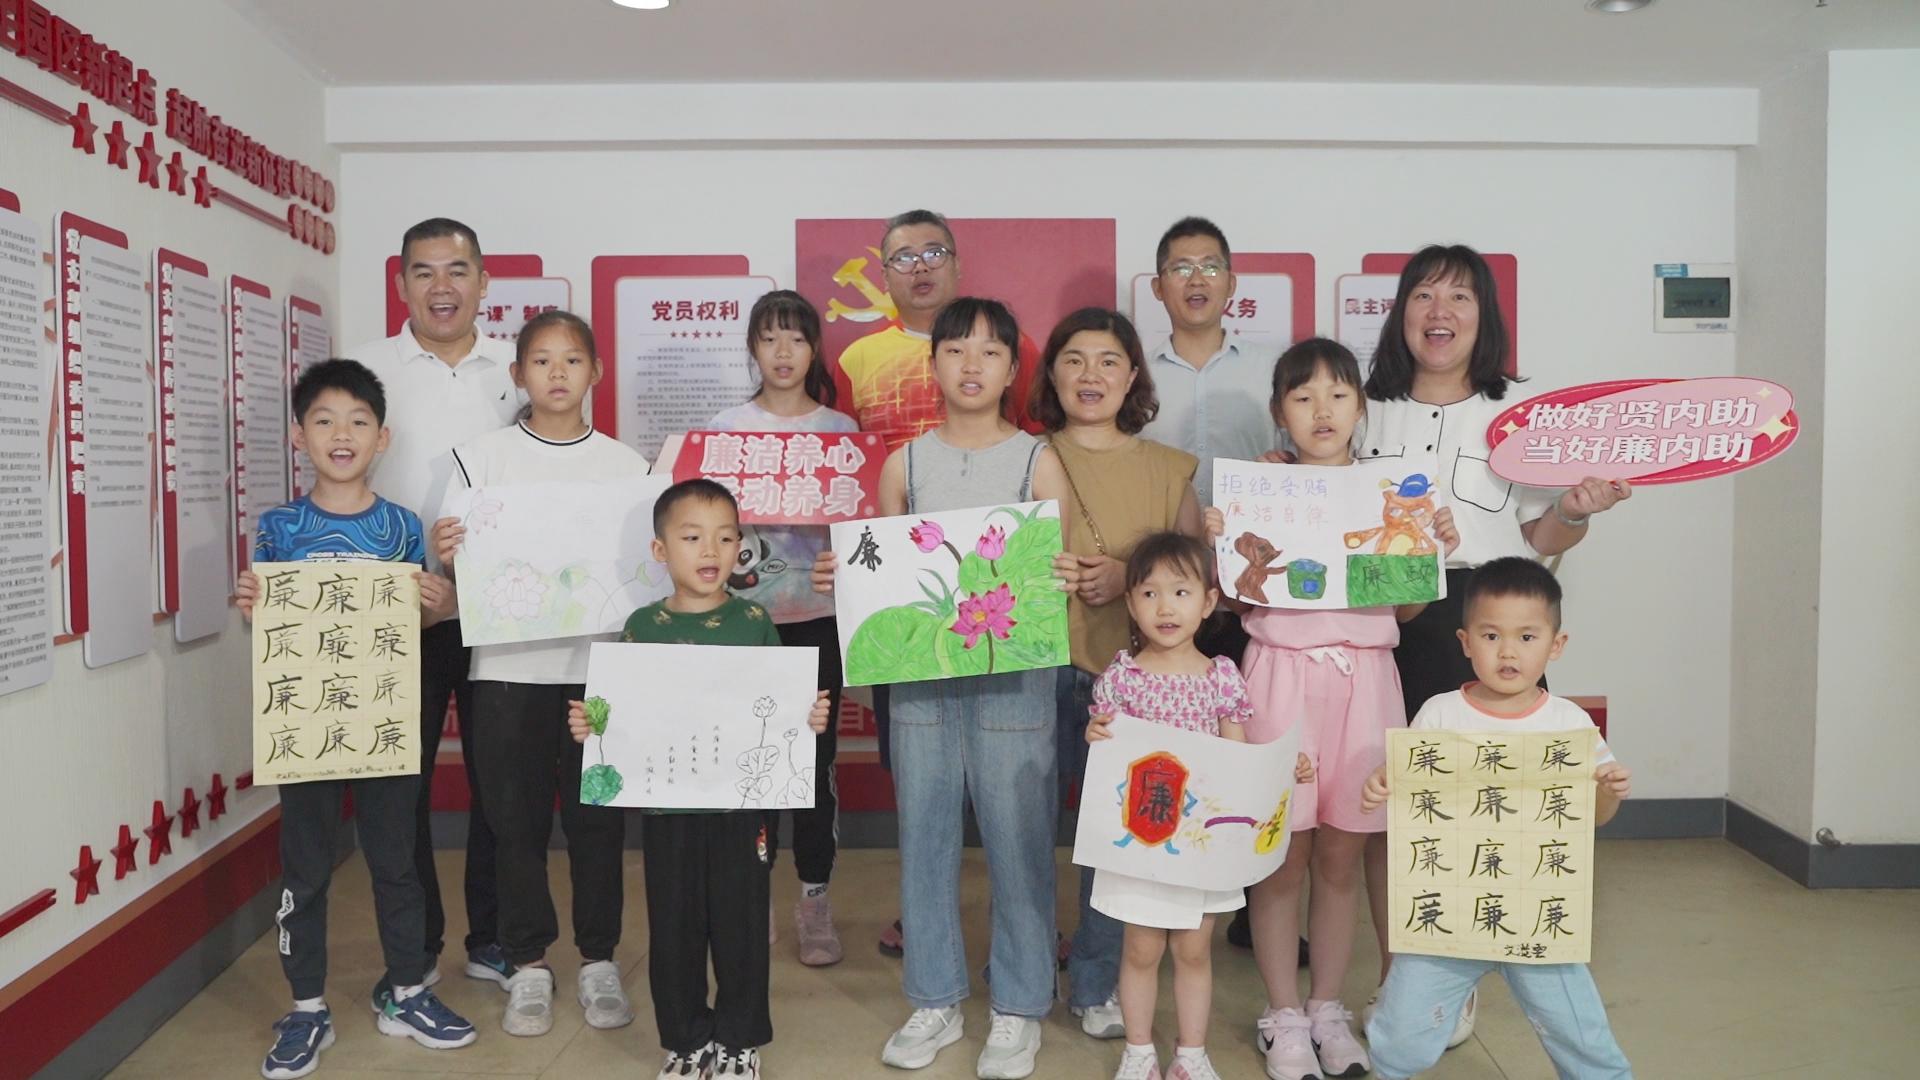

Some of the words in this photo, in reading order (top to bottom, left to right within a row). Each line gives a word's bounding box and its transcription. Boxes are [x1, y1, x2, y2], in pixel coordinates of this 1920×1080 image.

[651, 300, 739, 322] 党员权利
[1525, 397, 1758, 432] 做好贤内助
[700, 433, 866, 475] 廉洁养心
[1521, 432, 1754, 465] 当好廉内助
